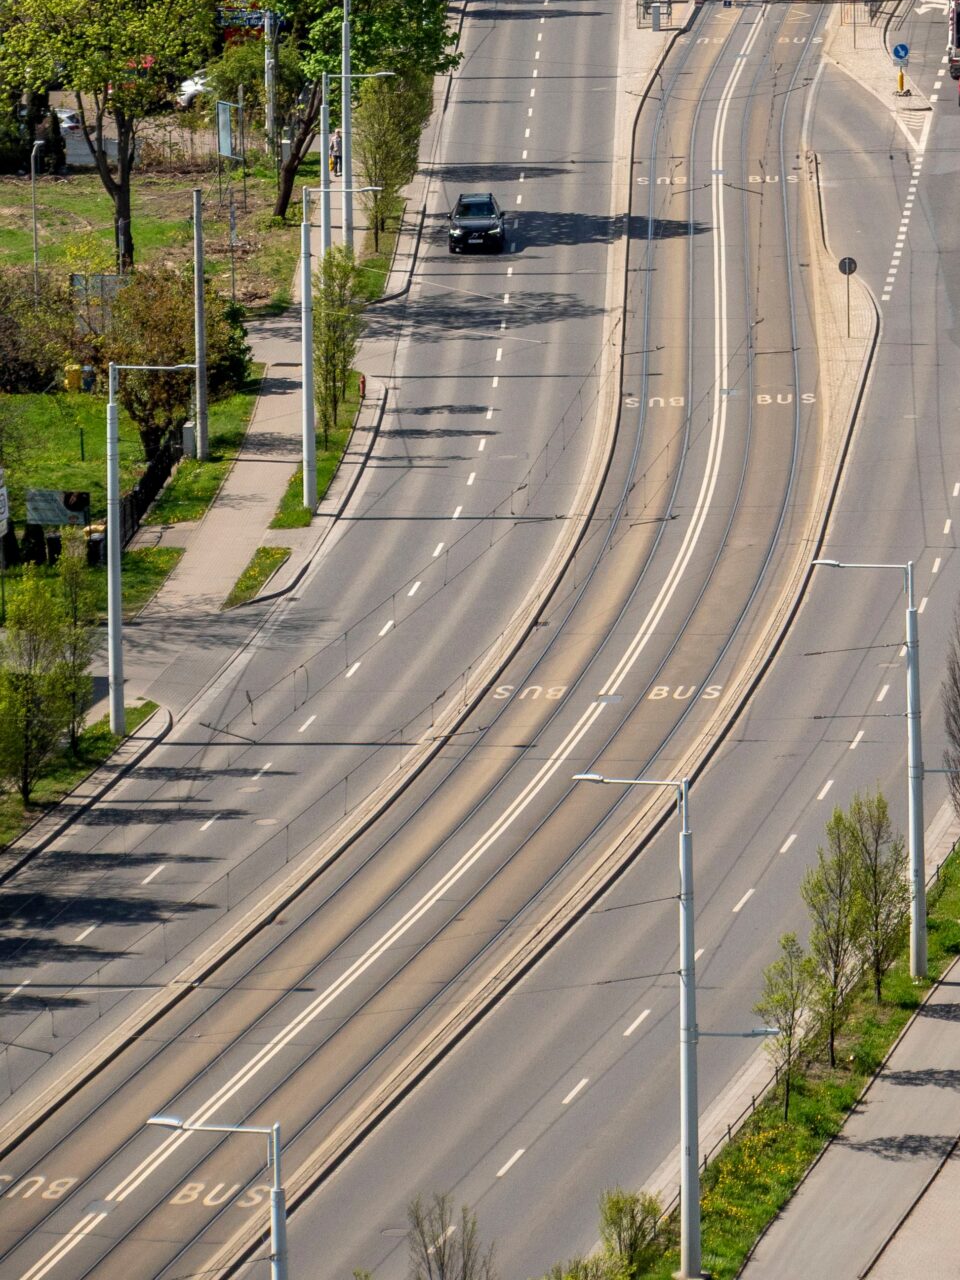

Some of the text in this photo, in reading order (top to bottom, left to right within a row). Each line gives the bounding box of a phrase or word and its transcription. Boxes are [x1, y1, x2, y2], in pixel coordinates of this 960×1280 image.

[636, 176, 688, 185] BUS
[748, 175, 800, 183] BUS
[624, 396, 685, 408] BUS
[756, 393, 817, 404] BUS
[492, 685, 569, 700] BUS
[647, 685, 723, 700] BUS
[168, 1182, 272, 1207] BUS
